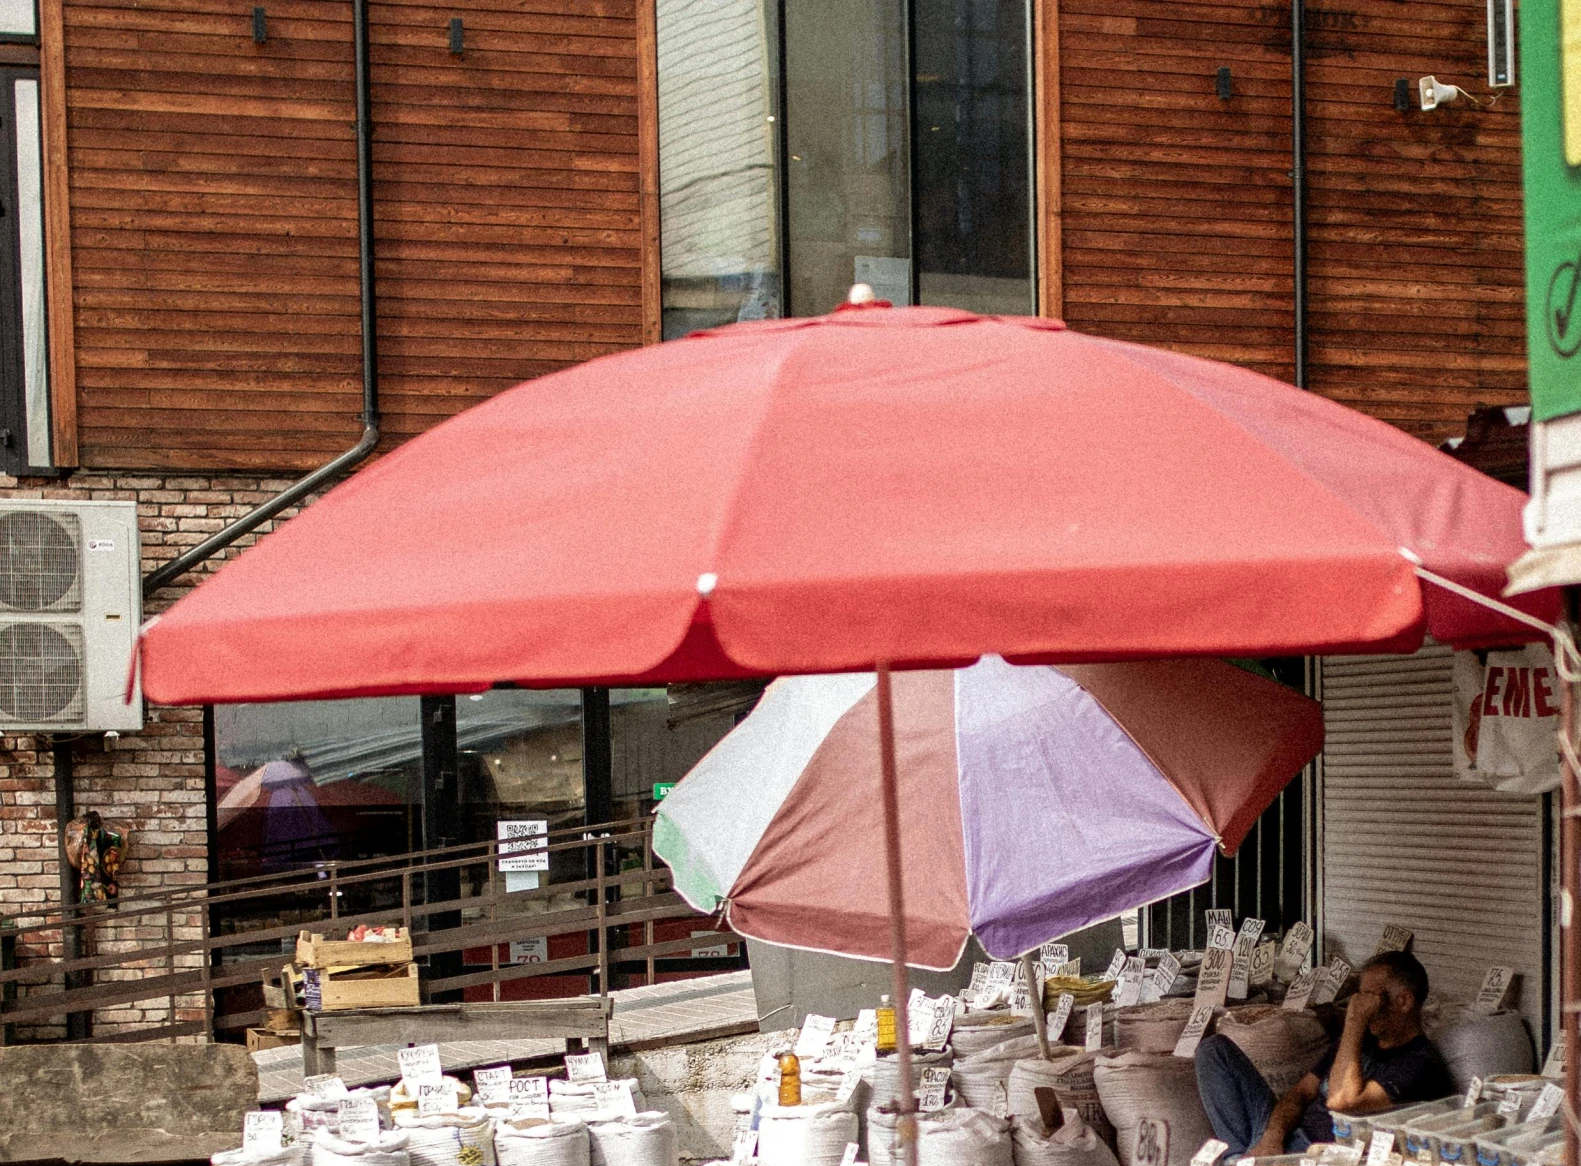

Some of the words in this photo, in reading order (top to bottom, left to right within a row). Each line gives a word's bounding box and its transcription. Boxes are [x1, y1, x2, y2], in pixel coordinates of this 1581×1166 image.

[1242, 919, 1262, 935] СОЯ
[1041, 945, 1068, 958] АРАХИС
[509, 1078, 540, 1093] РОСТ
